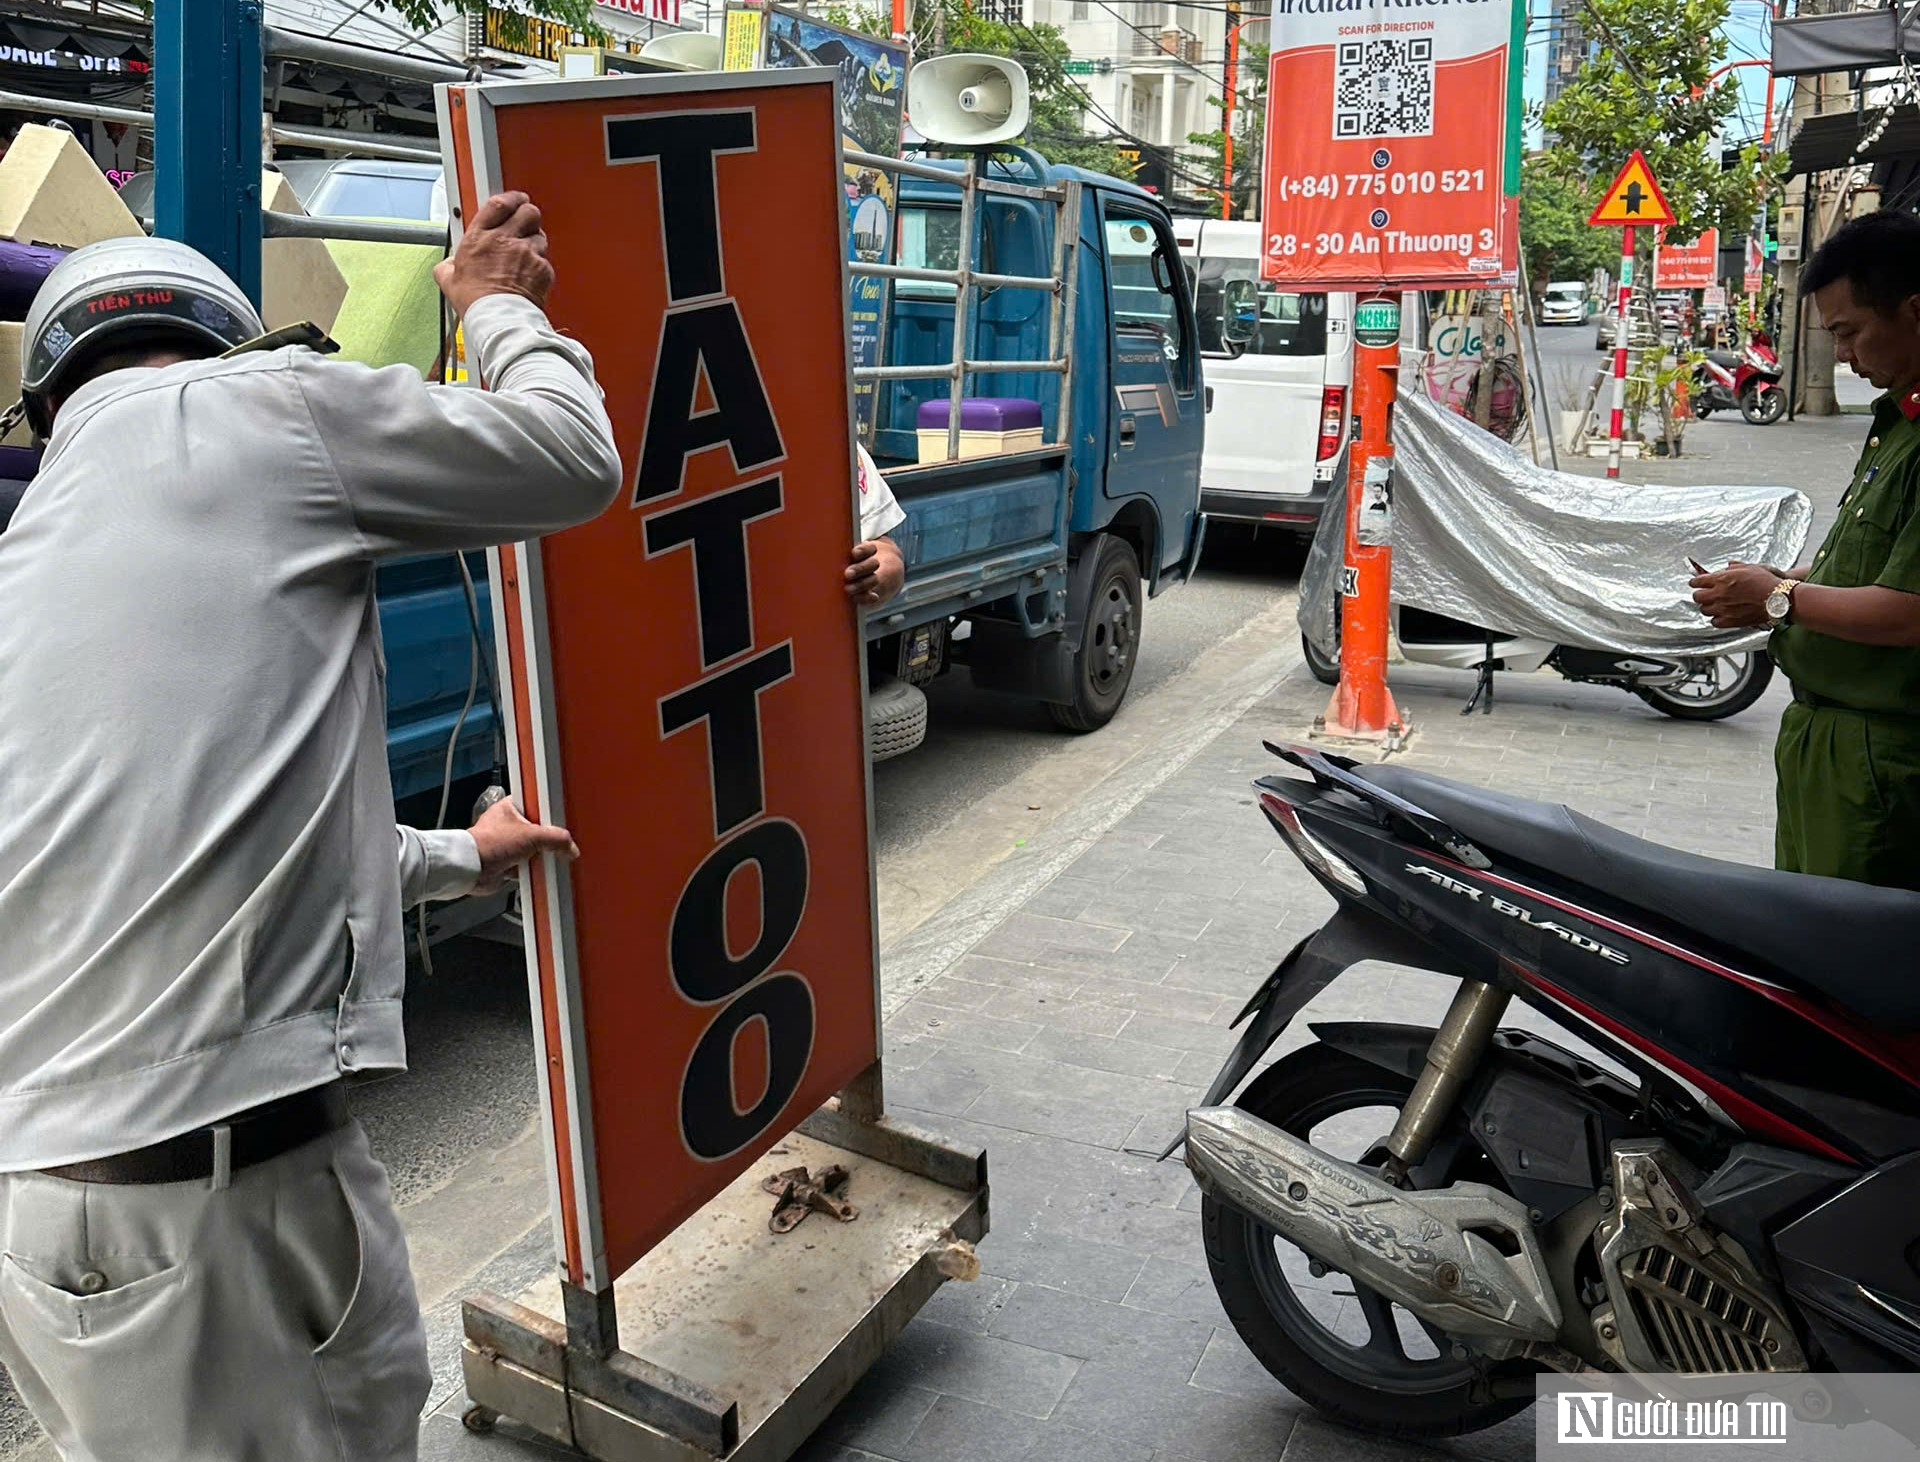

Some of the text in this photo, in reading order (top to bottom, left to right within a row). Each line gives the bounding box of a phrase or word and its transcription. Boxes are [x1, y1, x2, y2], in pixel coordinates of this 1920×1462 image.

[1338, 21, 1435, 36] SCAN FOR DIRECTION
[1280, 169, 1485, 201] (+84) 775 010 521
[1269, 234, 1297, 256] 28
[1315, 232, 1345, 254] 30
[1348, 231, 1380, 253] An
[1384, 230, 1473, 256] Thuong
[1478, 228, 1495, 251] 3
[603, 106, 816, 1162] TATTOO
[1405, 863, 1631, 965] AIR BLADE
[1308, 1157, 1369, 1199] HONDA
